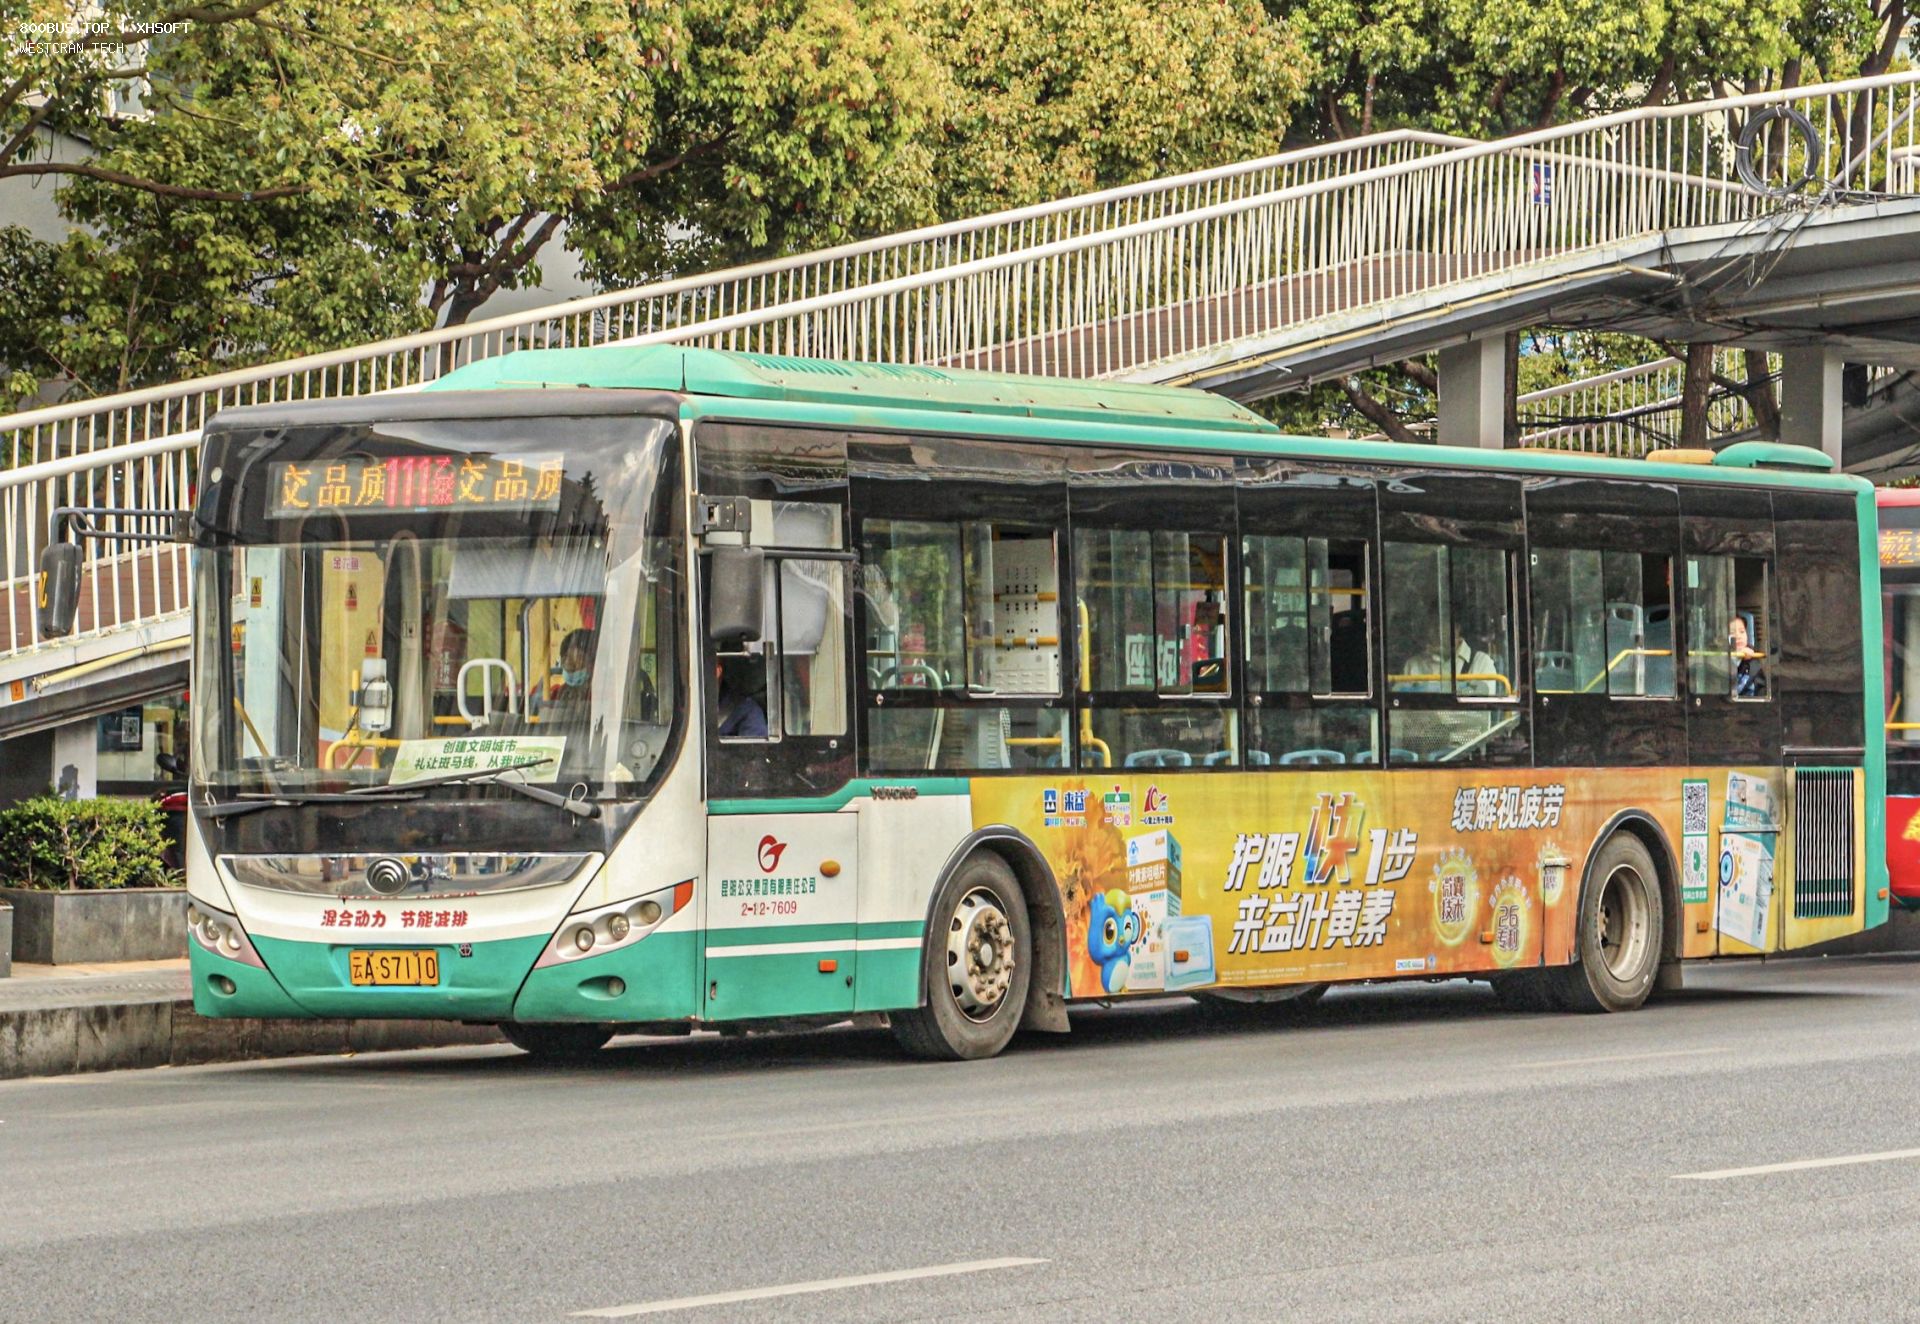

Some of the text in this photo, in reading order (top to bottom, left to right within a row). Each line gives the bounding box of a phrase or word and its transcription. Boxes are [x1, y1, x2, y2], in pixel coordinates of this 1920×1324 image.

[442, 739, 518, 754] 创建文明城市
[1064, 791, 1085, 811] 来益
[1451, 783, 1566, 832] 缓解视疲劳
[720, 877, 816, 897] 昆明公交集团有限责任公司
[321, 909, 469, 928] 混合动力 节能减排
[1227, 888, 1396, 954] 来益叶黄素
[1497, 904, 1520, 928] 26
